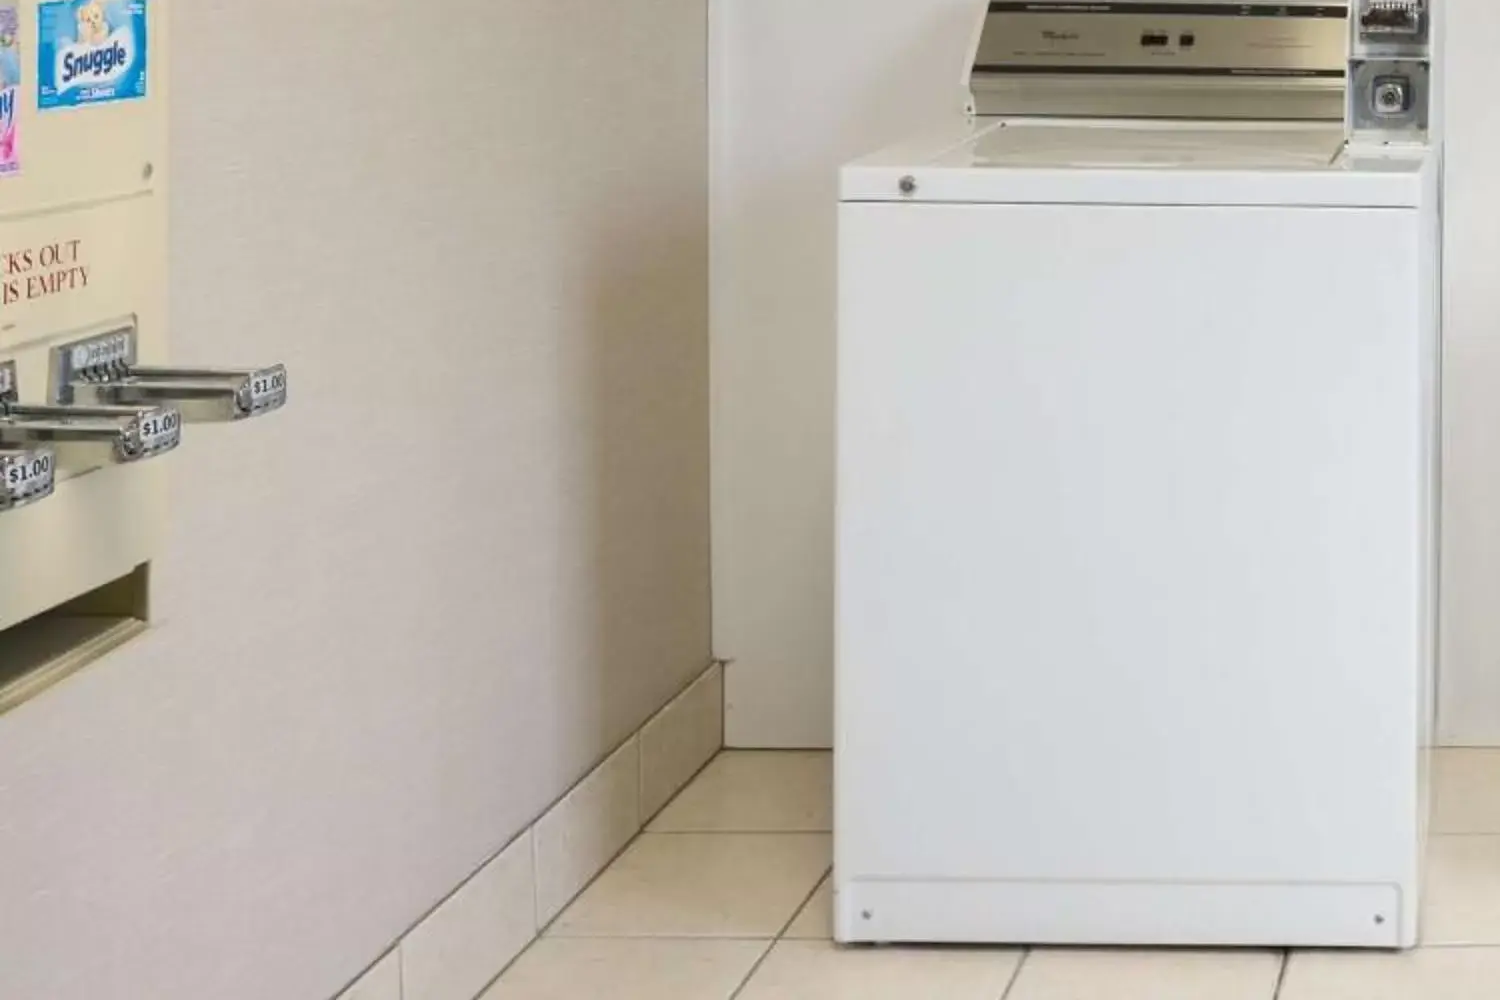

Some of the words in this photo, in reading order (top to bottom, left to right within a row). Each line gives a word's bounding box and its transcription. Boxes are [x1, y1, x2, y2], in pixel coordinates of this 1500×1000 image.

[62, 40, 126, 82] Snuggle
[1, 249, 33, 274] KS
[39, 239, 82, 267] OUT
[3, 279, 20, 305] IS
[26, 265, 90, 299] EMPTY
[143, 413, 177, 436] $1.00
[9, 455, 49, 483] $1.00
